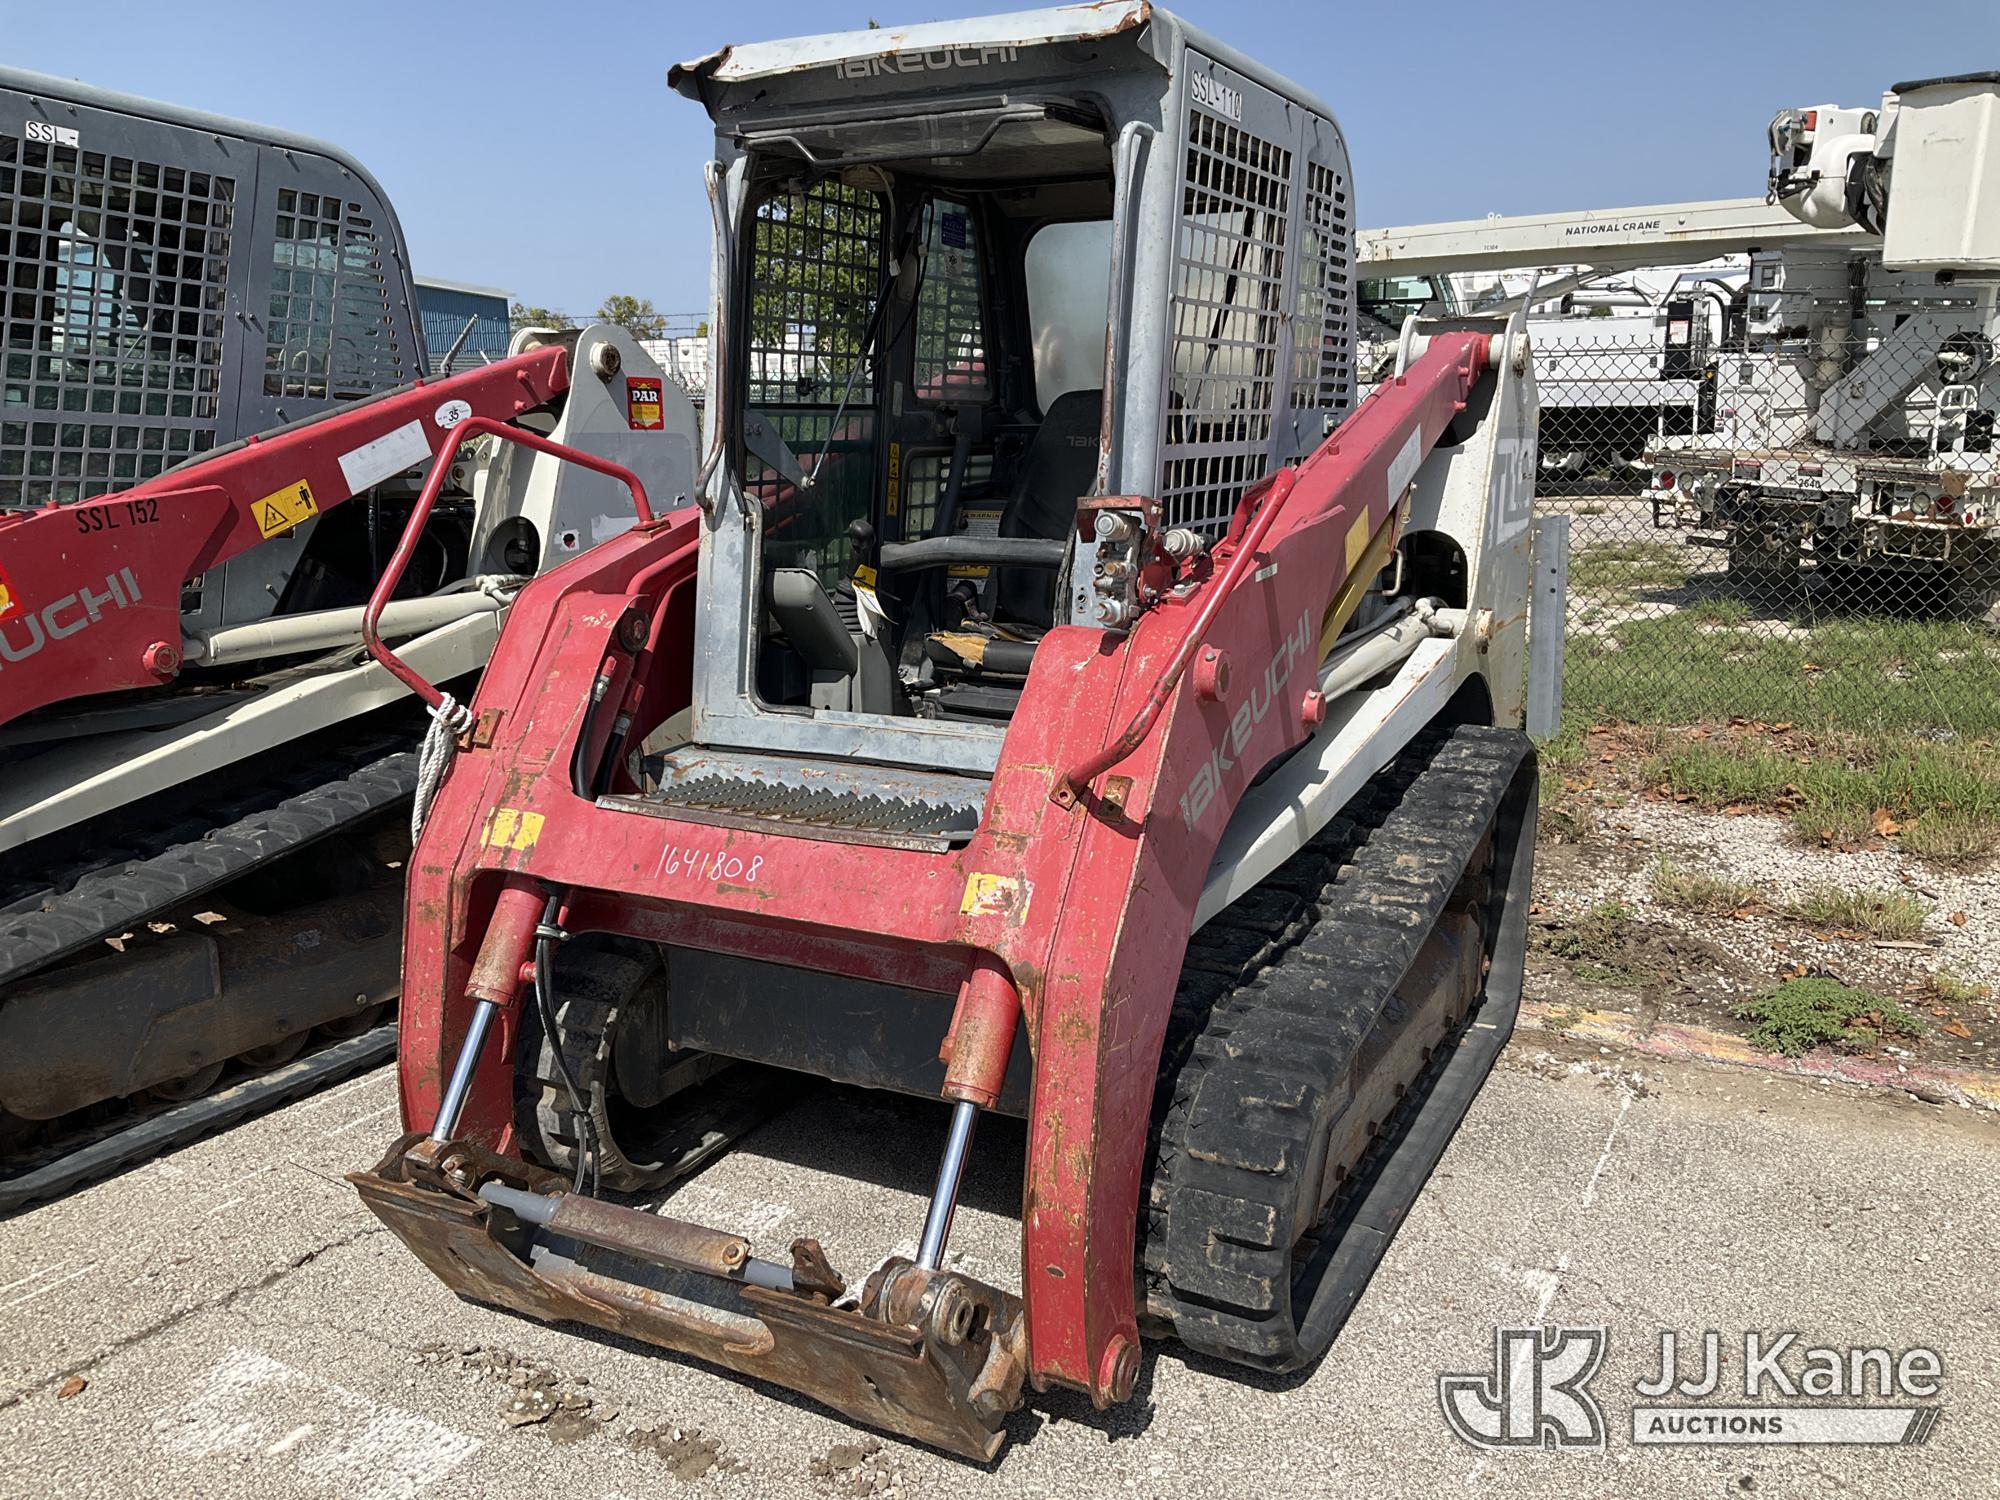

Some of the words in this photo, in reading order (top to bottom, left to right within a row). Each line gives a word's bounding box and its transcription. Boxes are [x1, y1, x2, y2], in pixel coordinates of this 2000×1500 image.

[1565, 224, 1620, 236] NATIONAL
[1622, 220, 1661, 232] CRANE
[632, 390, 658, 402] PAR
[448, 409, 459, 421] 35
[1065, 436, 1099, 447] TAK
[75, 505, 120, 534] SSL
[126, 499, 160, 526] 152
[0, 566, 142, 672] UCHI
[654, 844, 764, 881] 1641808
